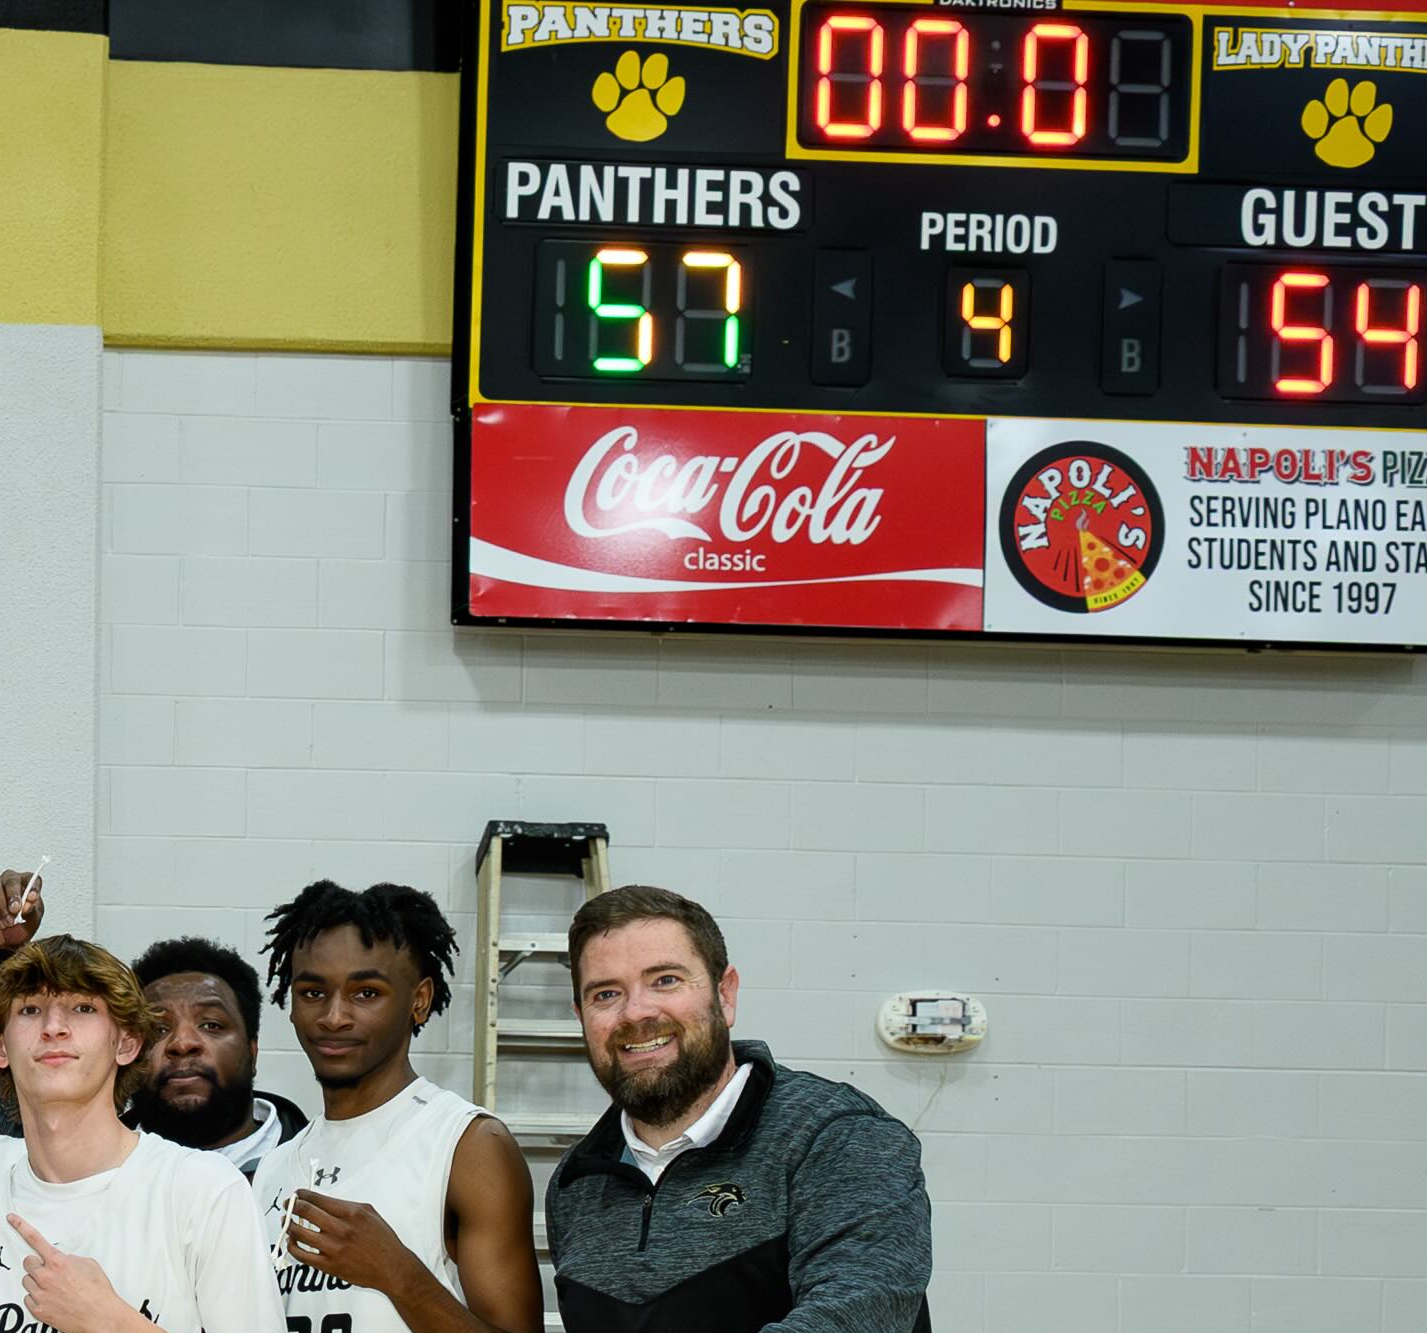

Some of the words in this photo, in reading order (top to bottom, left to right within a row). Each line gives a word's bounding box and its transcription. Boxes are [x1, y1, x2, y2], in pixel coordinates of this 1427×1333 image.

[507, 4, 774, 55] PANTHERS
[1216, 31, 1311, 66] LADY
[1315, 34, 1427, 69] PANTH
[506, 162, 801, 229] PANTHERS
[920, 211, 1058, 254] PERIOD
[1240, 188, 1426, 250] GUEST
[588, 248, 741, 372] 57
[961, 282, 1014, 364] 4
[831, 329, 852, 364] B
[1270, 271, 1421, 395] 54
[1120, 338, 1142, 373] B
[564, 426, 896, 545] Coca-Cola
[1185, 447, 1375, 486] NAPOLI'S
[1382, 450, 1427, 486] PIZ
[1017, 458, 1147, 552] NAPOLI'S
[1051, 490, 1107, 522] PIZZA
[1189, 495, 1296, 529] SERVING
[1305, 498, 1387, 531] PLANO
[1396, 500, 1427, 532] EA
[684, 547, 766, 572] classic
[1187, 537, 1318, 572] STUDENTS
[1325, 541, 1377, 573] AND
[1385, 541, 1427, 574] STA
[1248, 580, 1322, 613] SINCE
[1333, 582, 1397, 615] 1997
